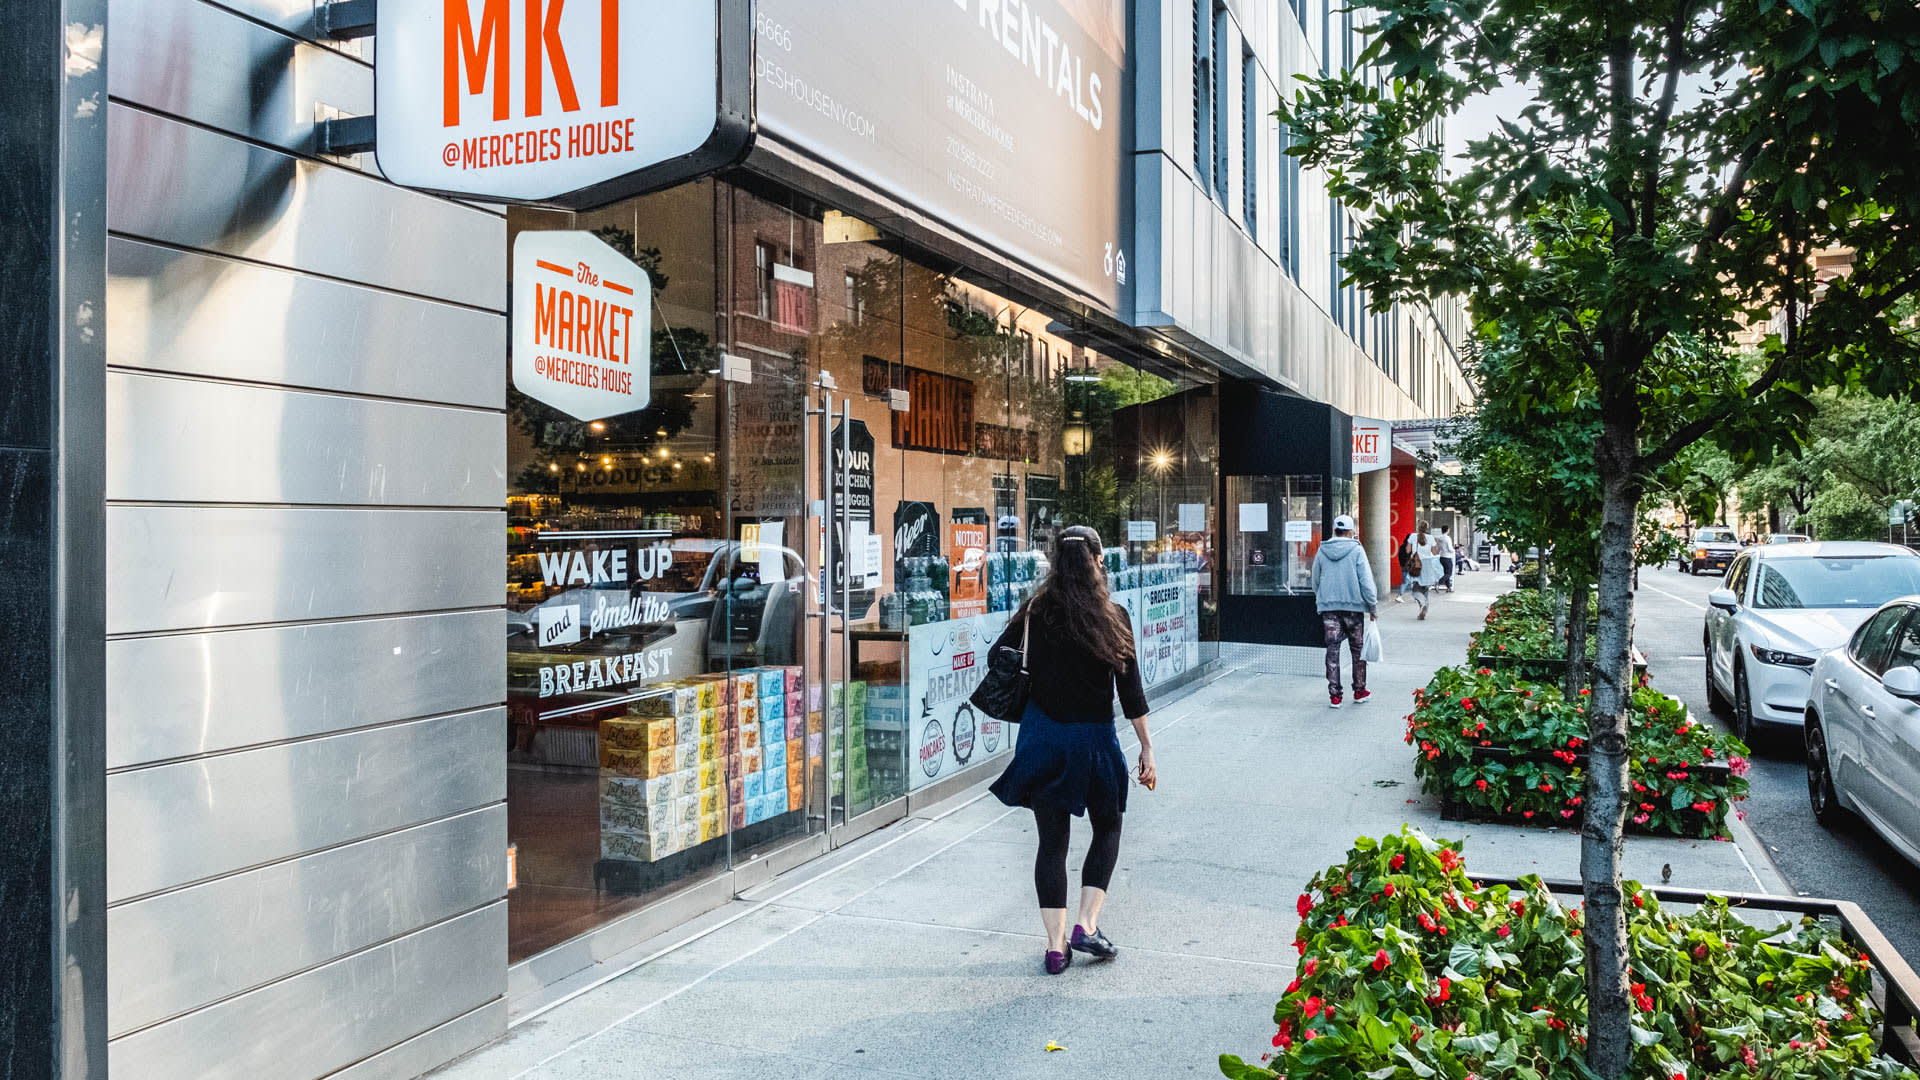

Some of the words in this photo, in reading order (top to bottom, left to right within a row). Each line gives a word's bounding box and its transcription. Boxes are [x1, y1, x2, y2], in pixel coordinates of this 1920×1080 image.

[978, 0, 1104, 131] RENTALS
[443, 128, 561, 171] @MERCEDES
[568, 118, 635, 158] HOUSE
[577, 261, 600, 287] The
[534, 282, 633, 365] MARKET
[534, 355, 599, 389] @MERCEDES
[602, 367, 632, 395] HOUSE
[835, 448, 870, 471] YOUR
[835, 473, 871, 490] KICHEN,
[538, 549, 628, 587] WAKE
[637, 547, 673, 581] UP
[546, 608, 571, 643] and
[589, 595, 641, 640] Smell
[643, 596, 671, 623] the
[539, 648, 673, 698] BREAKFAST
